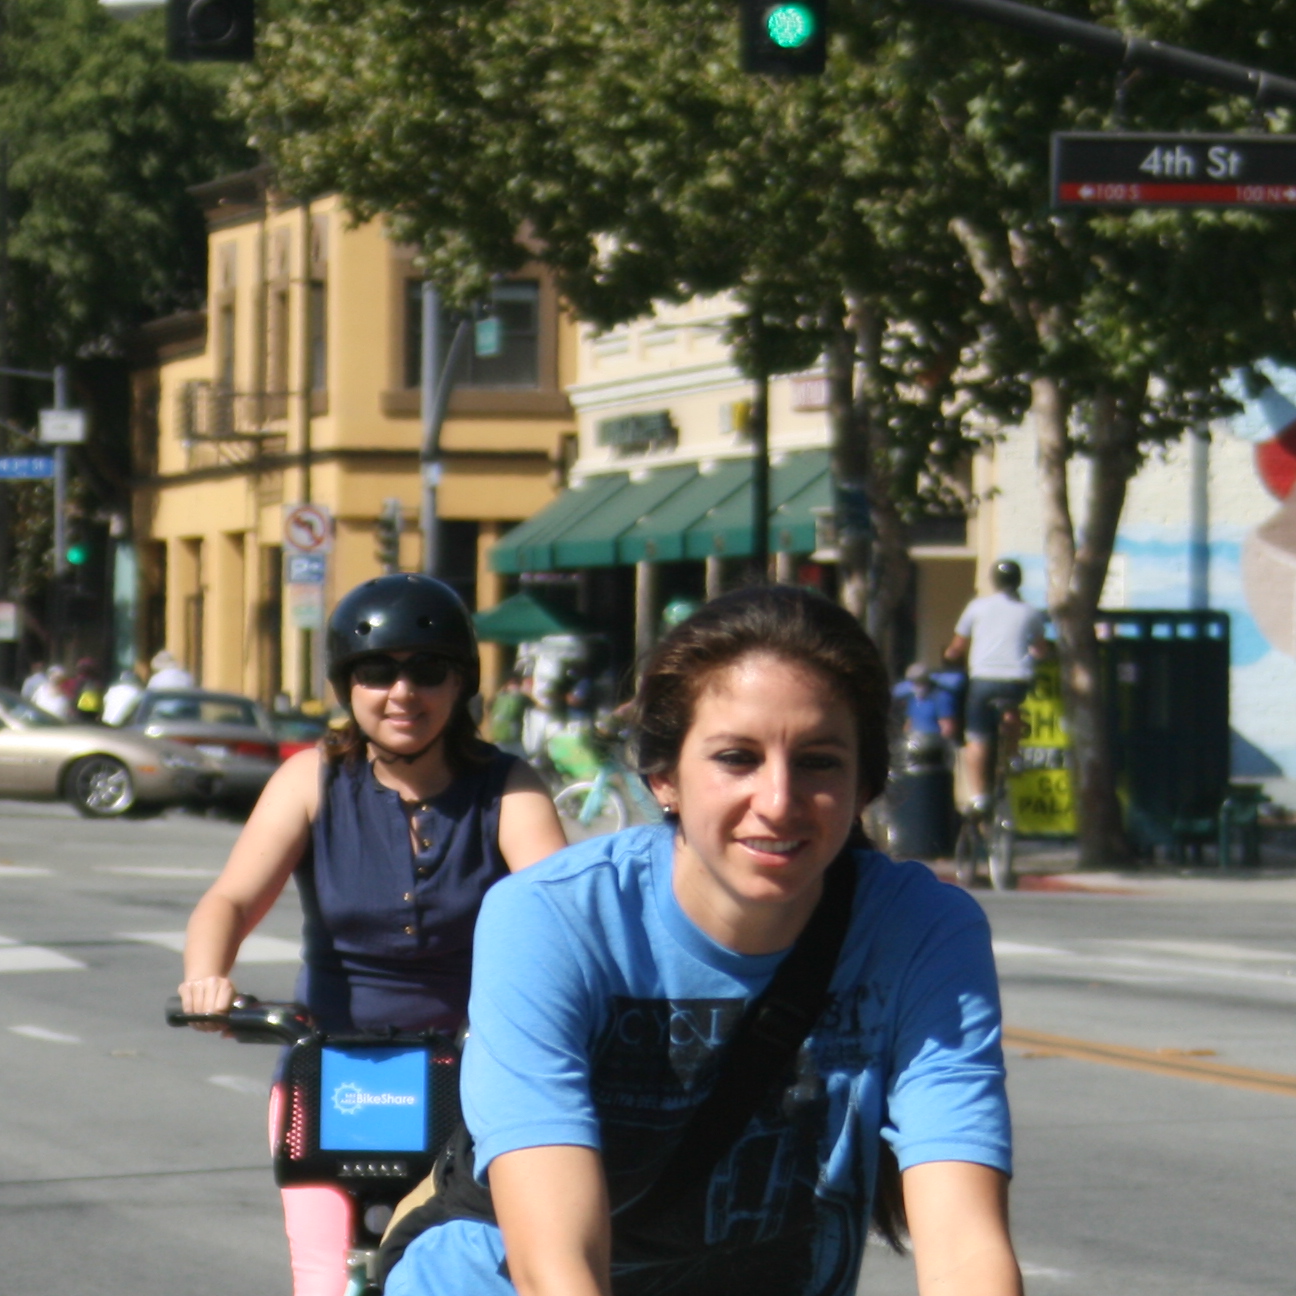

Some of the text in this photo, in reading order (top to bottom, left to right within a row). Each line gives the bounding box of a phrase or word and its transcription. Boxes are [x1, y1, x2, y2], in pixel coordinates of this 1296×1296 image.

[1138, 145, 1243, 178] 4th St
[1097, 184, 1128, 199] 100
[1236, 186, 1263, 201] 100
[357, 1093, 415, 1105] BikeShare
